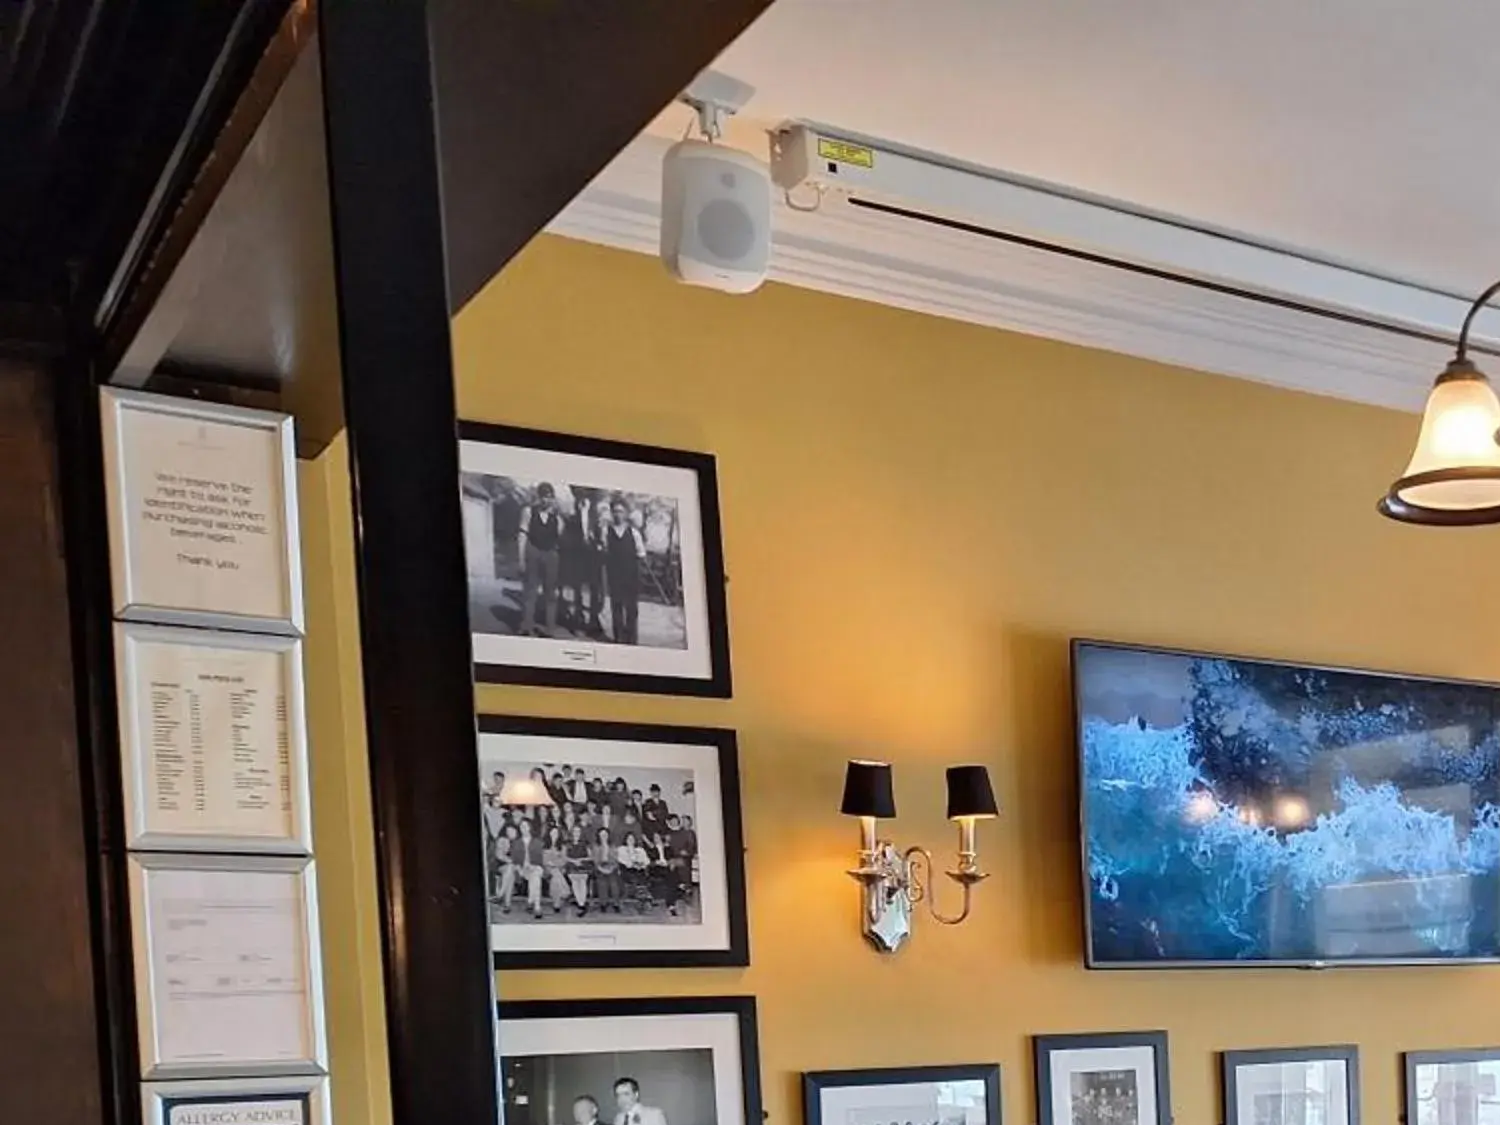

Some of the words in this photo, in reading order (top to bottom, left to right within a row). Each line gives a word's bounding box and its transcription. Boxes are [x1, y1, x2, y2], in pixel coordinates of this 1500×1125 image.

[229, 482, 253, 494] the
[230, 509, 265, 521] when
[177, 1112, 240, 1125] ALLERGY
[245, 1109, 296, 1121] ADVICE
